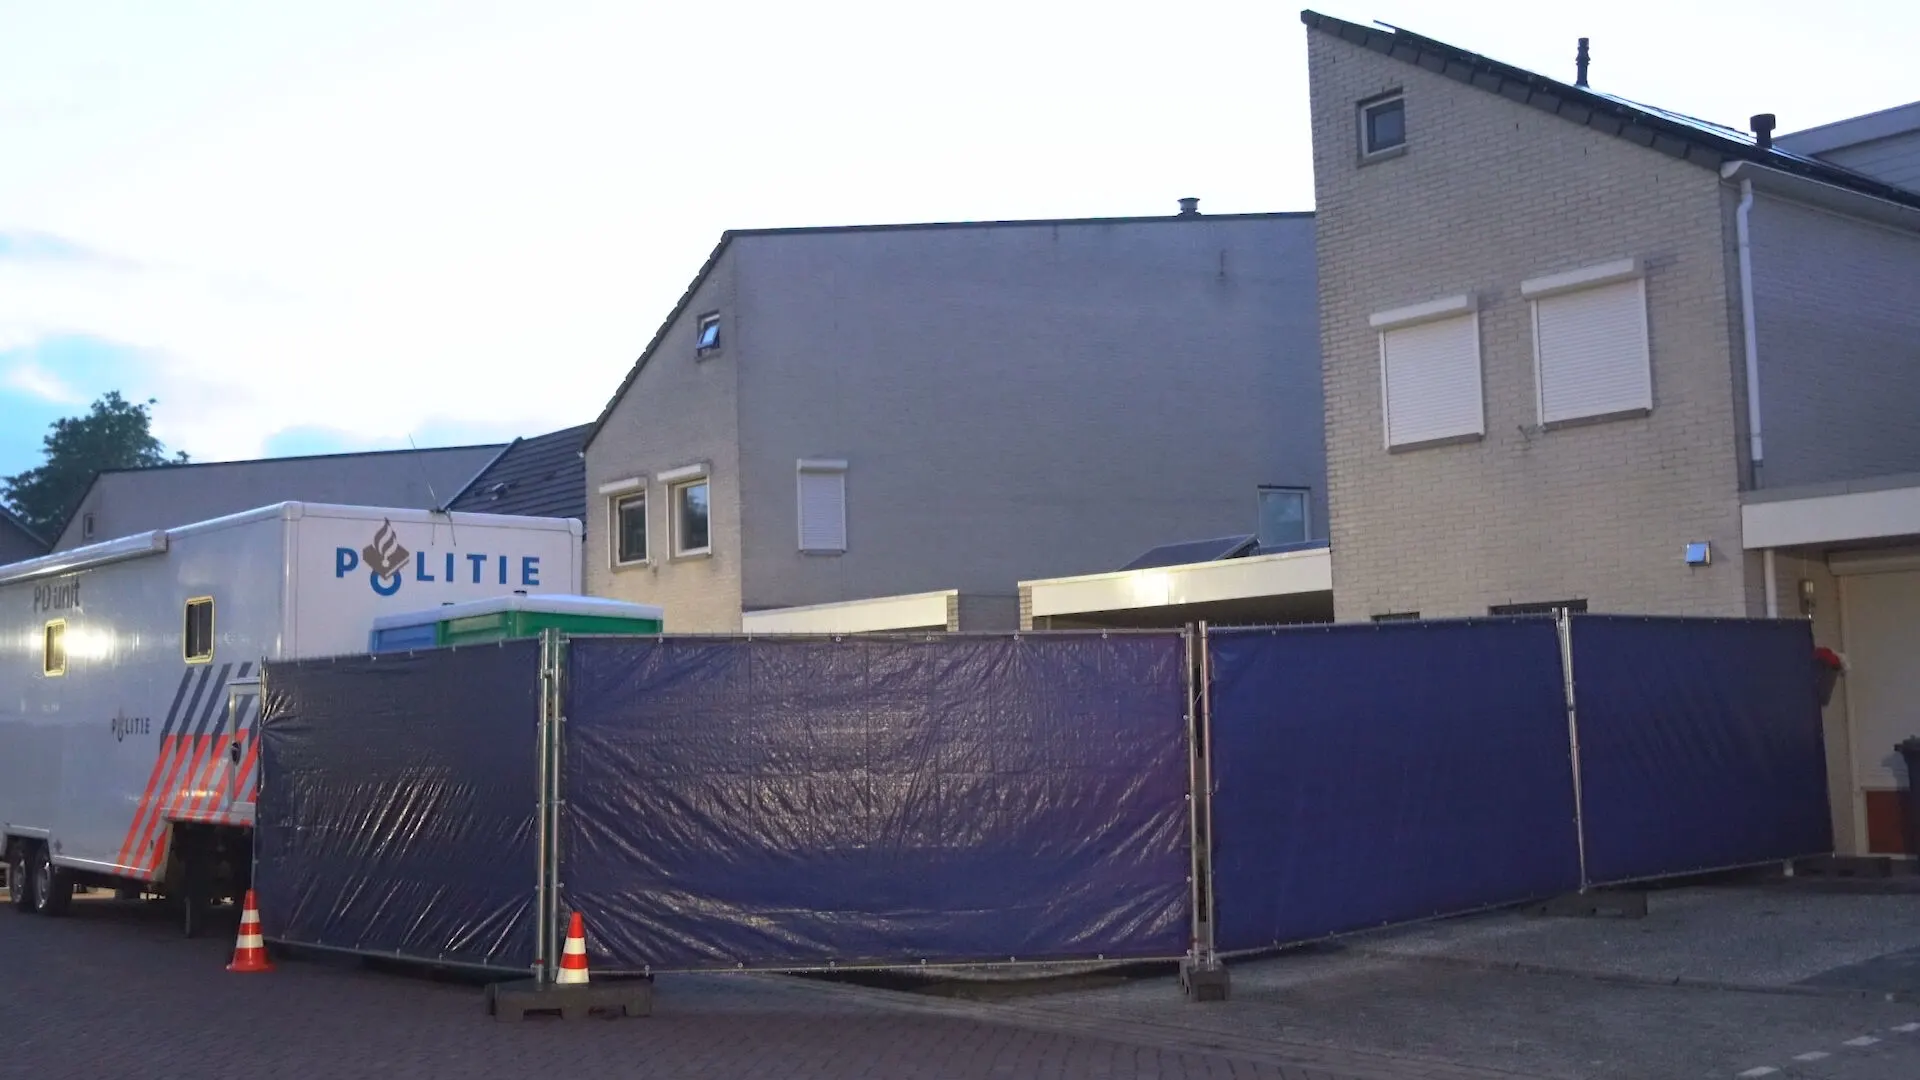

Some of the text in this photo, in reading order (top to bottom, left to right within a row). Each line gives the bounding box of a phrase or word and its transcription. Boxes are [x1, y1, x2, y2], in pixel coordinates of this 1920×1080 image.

[336, 547, 540, 596] POLITIE
[54, 576, 80, 609] unit
[112, 717, 150, 742] POLITIE
